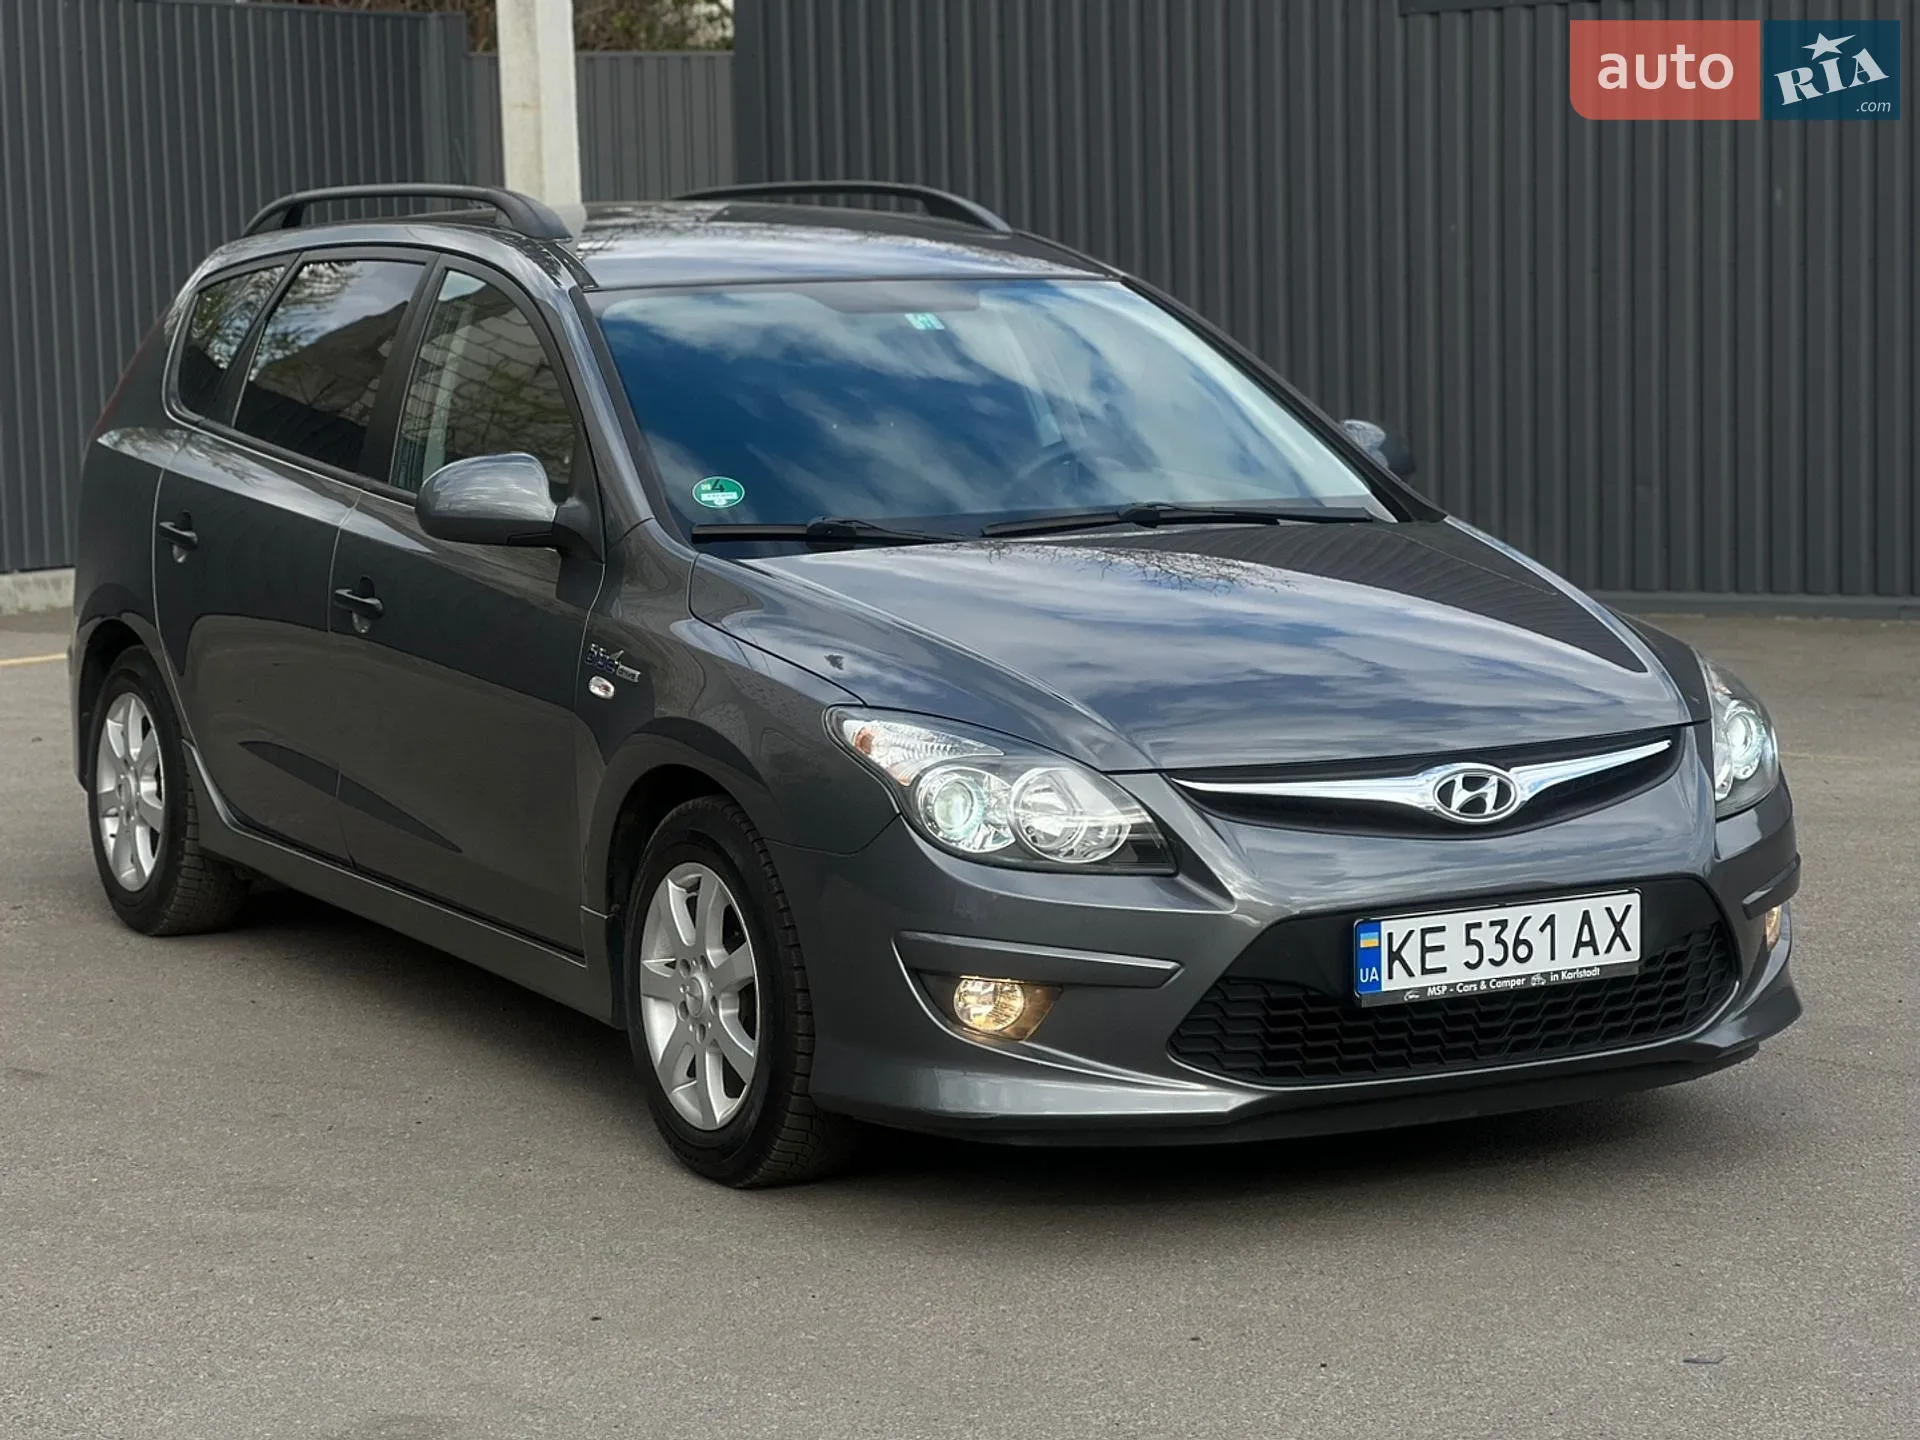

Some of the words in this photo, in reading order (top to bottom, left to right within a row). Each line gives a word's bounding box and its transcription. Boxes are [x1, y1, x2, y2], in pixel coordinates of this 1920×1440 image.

[711, 479, 725, 492] 4
[1387, 925, 1448, 980] KE
[1463, 913, 1556, 970] 5361
[1572, 904, 1632, 959] AX
[1360, 967, 1380, 983] UA
[1427, 985, 1448, 997] MSP
[1456, 982, 1478, 994] Cars
[1480, 980, 1487, 990] &
[1489, 977, 1526, 990] Camper
[1550, 972, 1559, 982] in
[1561, 966, 1600, 981] Karlstadt
